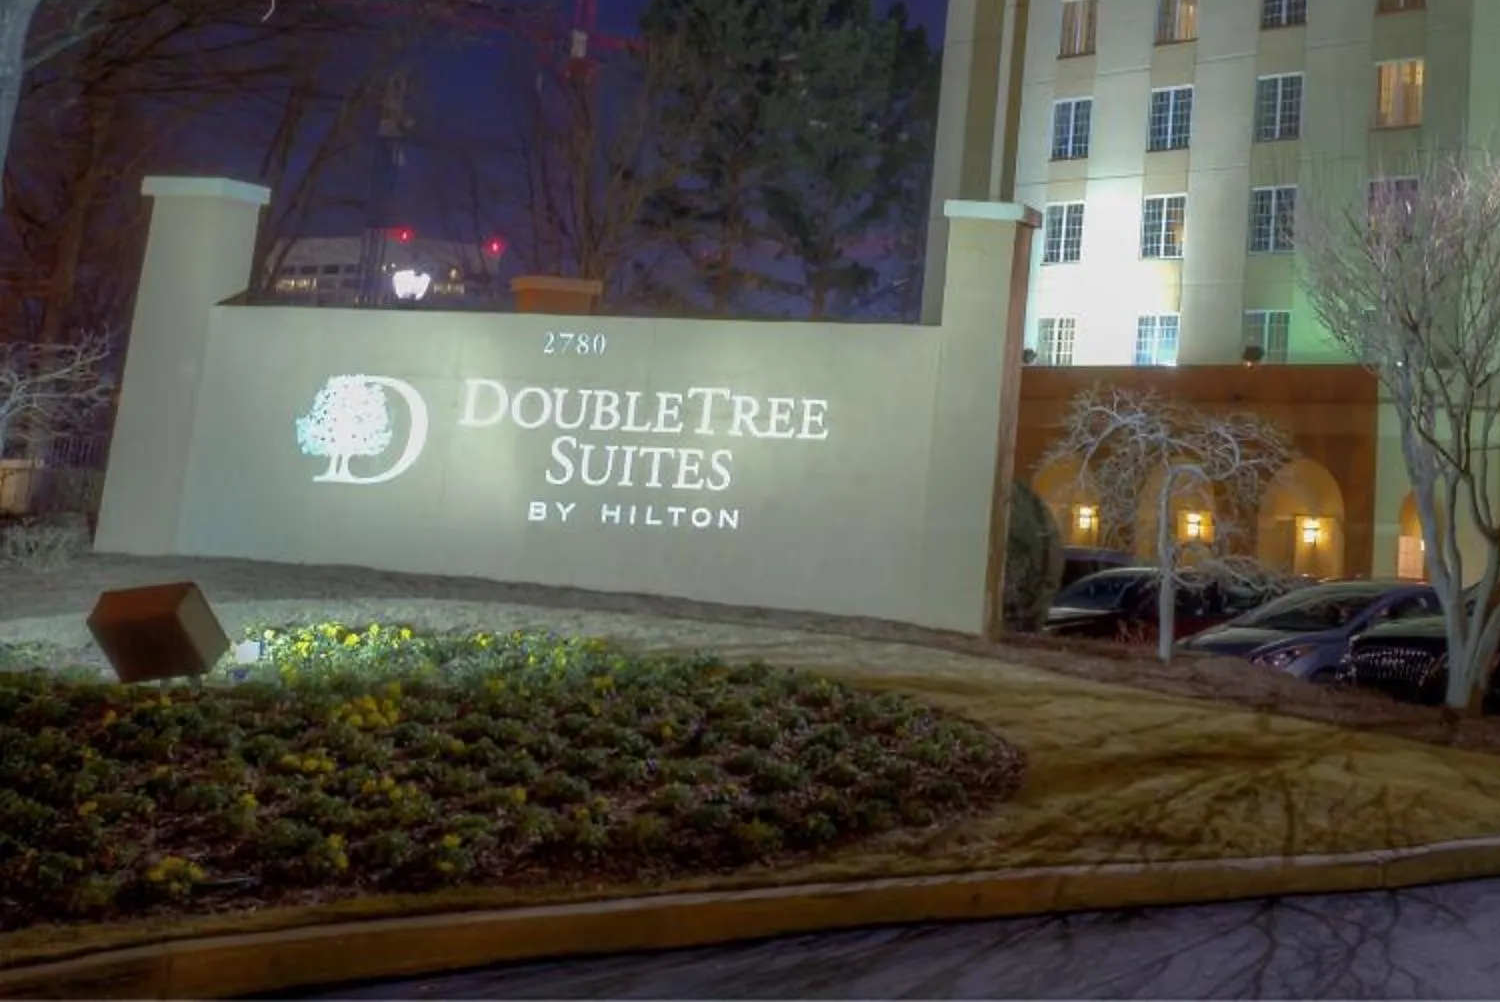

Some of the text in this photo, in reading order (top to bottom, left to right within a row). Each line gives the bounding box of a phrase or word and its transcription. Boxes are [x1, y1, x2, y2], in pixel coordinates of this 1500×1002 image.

[542, 331, 608, 356] 2780
[456, 377, 830, 440] DOUBLETREE
[544, 436, 734, 491] SUITES
[527, 501, 740, 529] BY HILTON
